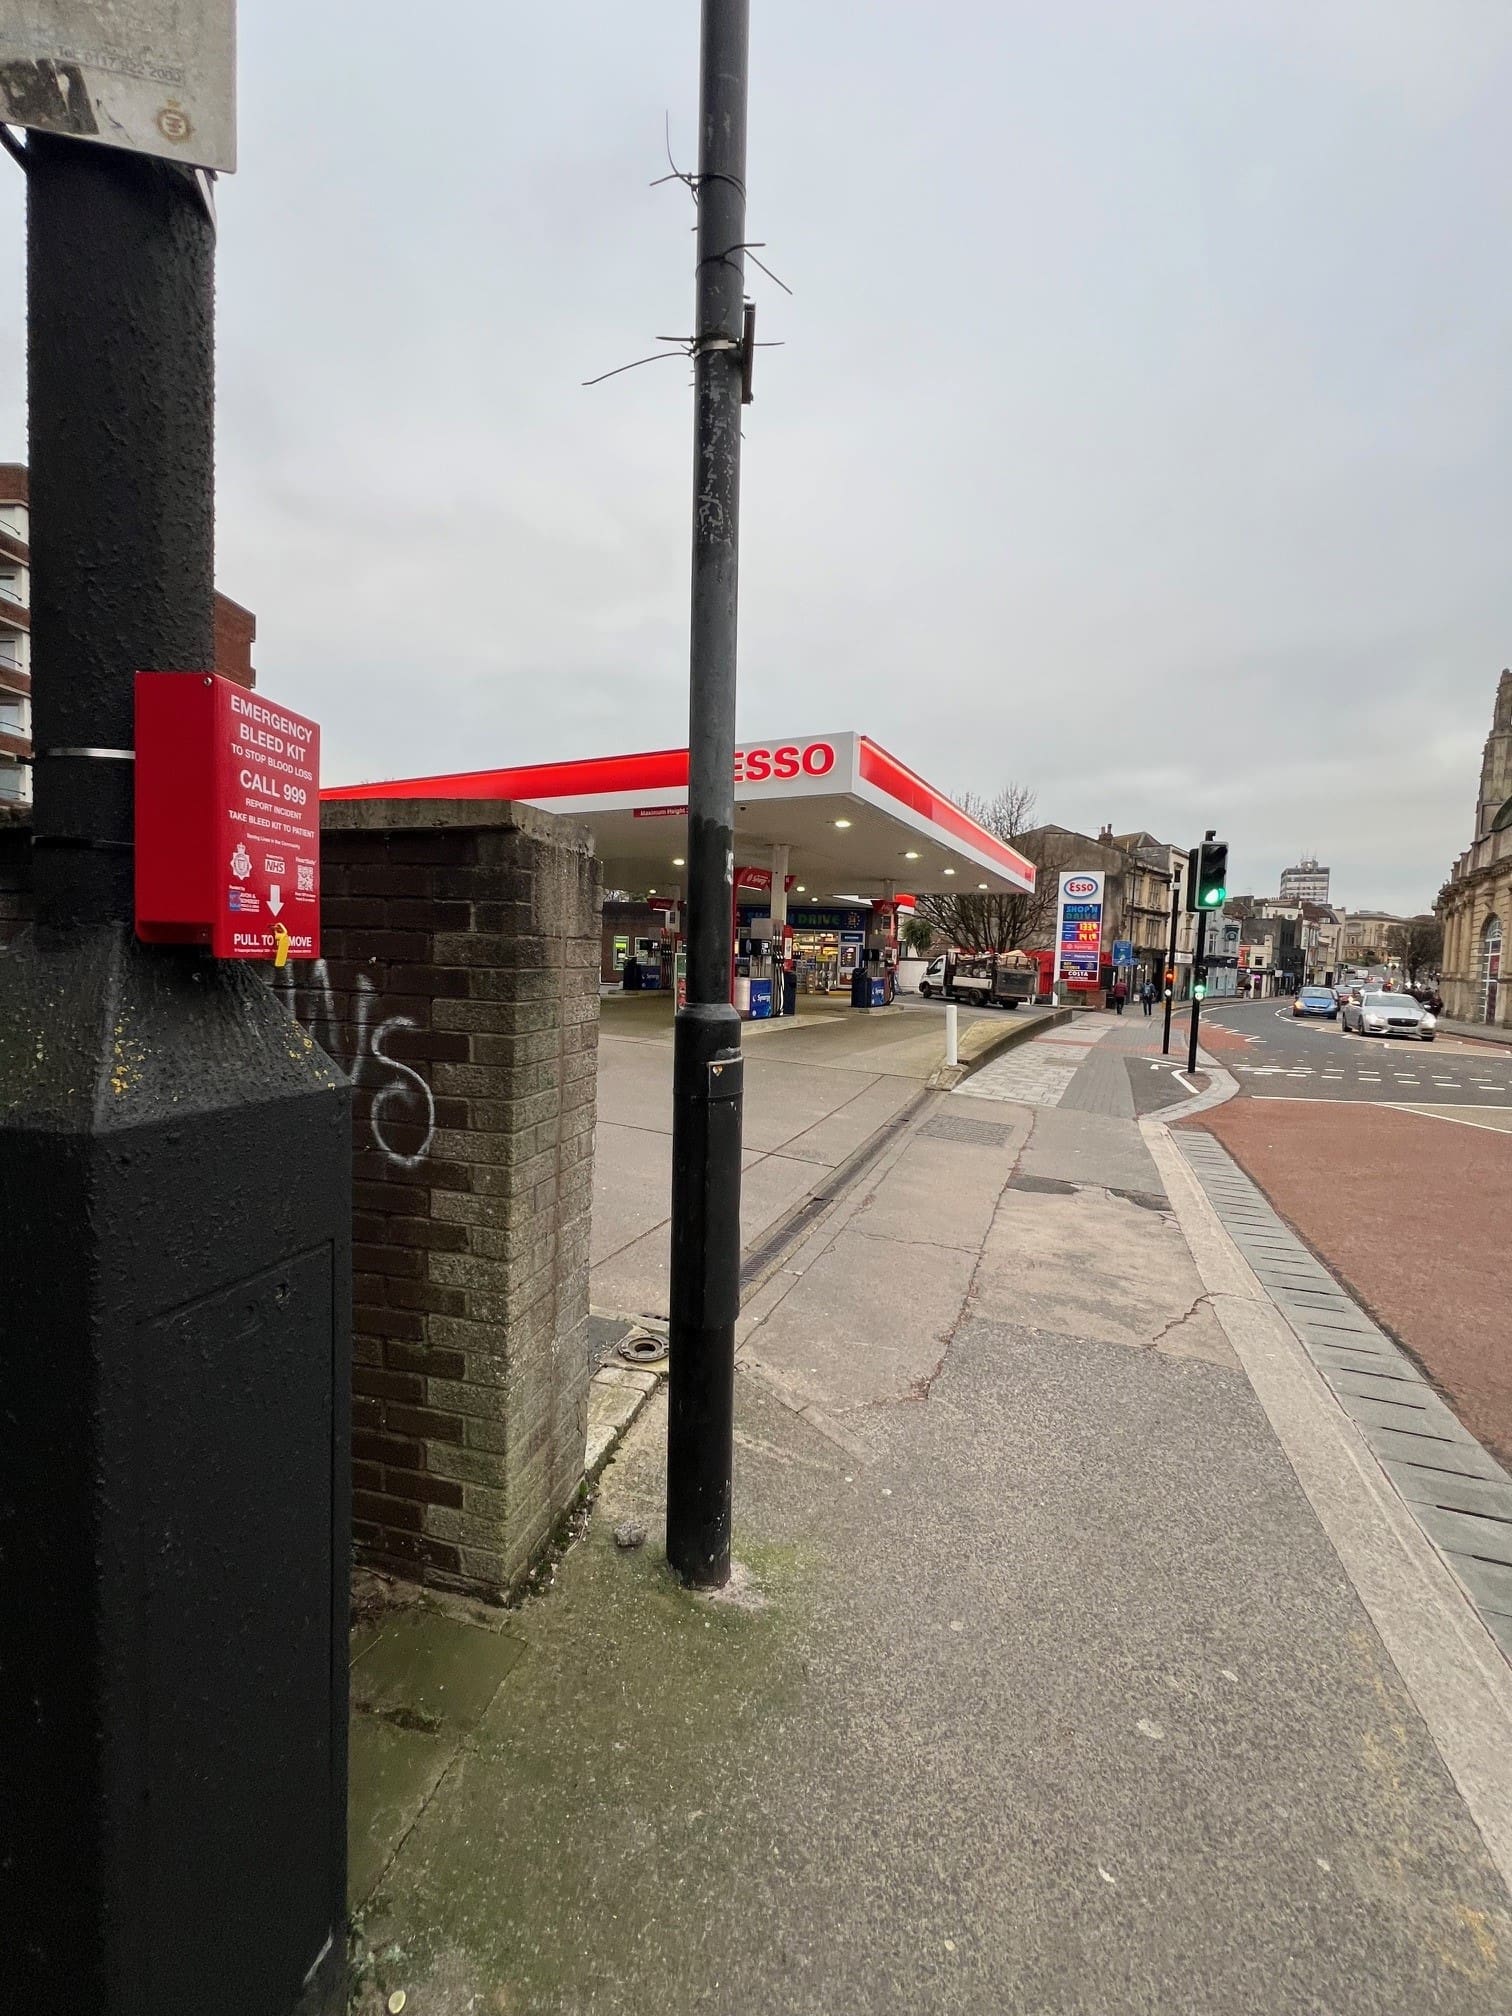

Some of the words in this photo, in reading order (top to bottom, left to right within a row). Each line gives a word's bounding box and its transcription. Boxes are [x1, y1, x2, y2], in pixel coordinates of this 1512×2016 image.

[230, 694, 313, 743] EMERGENCY
[240, 723, 284, 754] BLEED
[286, 742, 306, 763] KIT
[231, 743, 244, 756] TO
[245, 749, 266, 763] STOP
[268, 757, 294, 774] BLOOD
[295, 767, 313, 781] LOSS
[240, 769, 281, 798] CALL
[283, 784, 307, 806] 999
[245, 797, 273, 813] REPORT
[274, 805, 302, 820] INCIDENT
[228, 810, 247, 823] TAKE
[248, 814, 271, 829] BLEED
[271, 819, 282, 831] KIT
[283, 824, 292, 833] TO
[292, 826, 315, 839] PATIENT
[266, 861, 284, 873] NHS
[797, 914, 840, 925] DRIVE
[234, 933, 260, 946] PULL
[262, 934, 274, 946] TO
